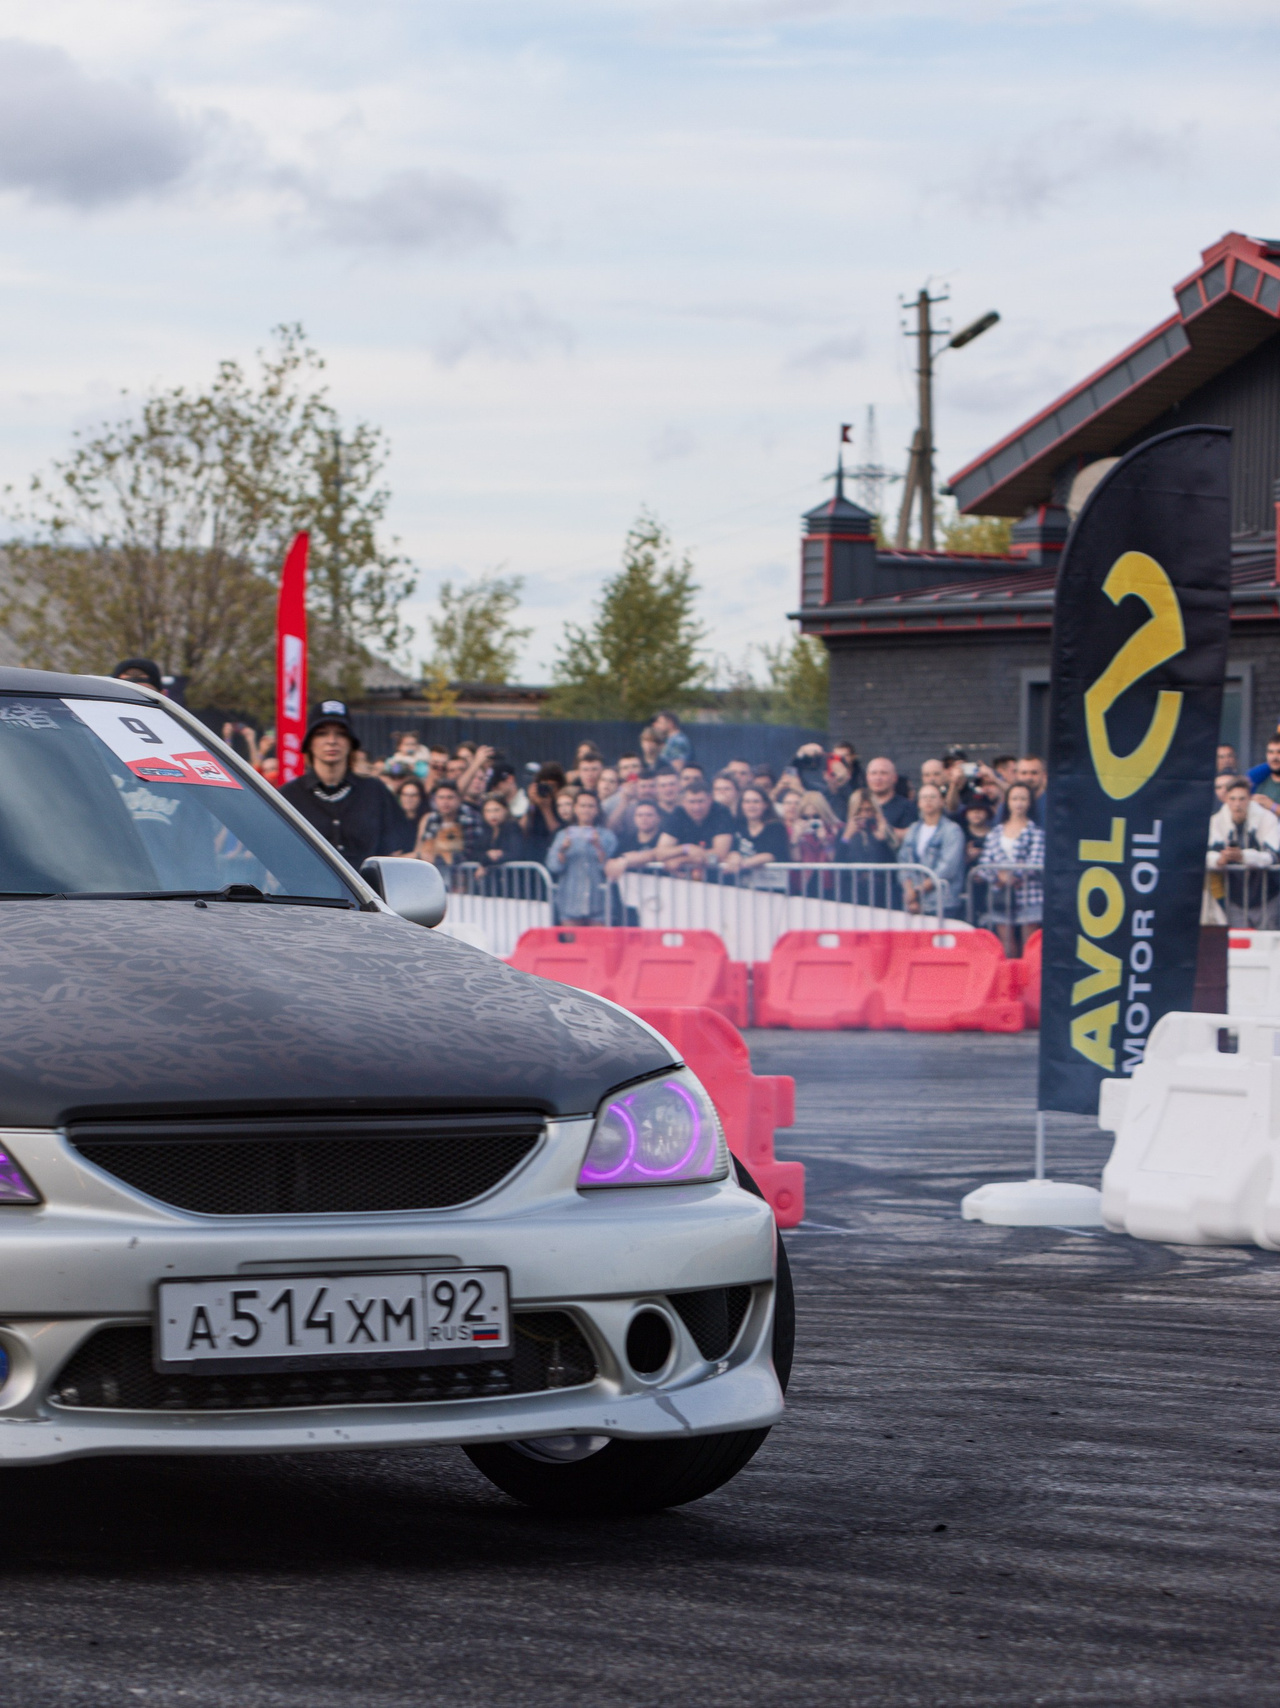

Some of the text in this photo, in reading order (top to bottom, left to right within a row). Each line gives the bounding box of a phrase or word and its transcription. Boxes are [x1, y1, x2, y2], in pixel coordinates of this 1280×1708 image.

[118, 717, 163, 744] 9
[1130, 818, 1162, 894] OIL
[1070, 817, 1126, 1073] AVOL
[433, 1278, 486, 1323] 92
[429, 1325, 471, 1343] RUS
